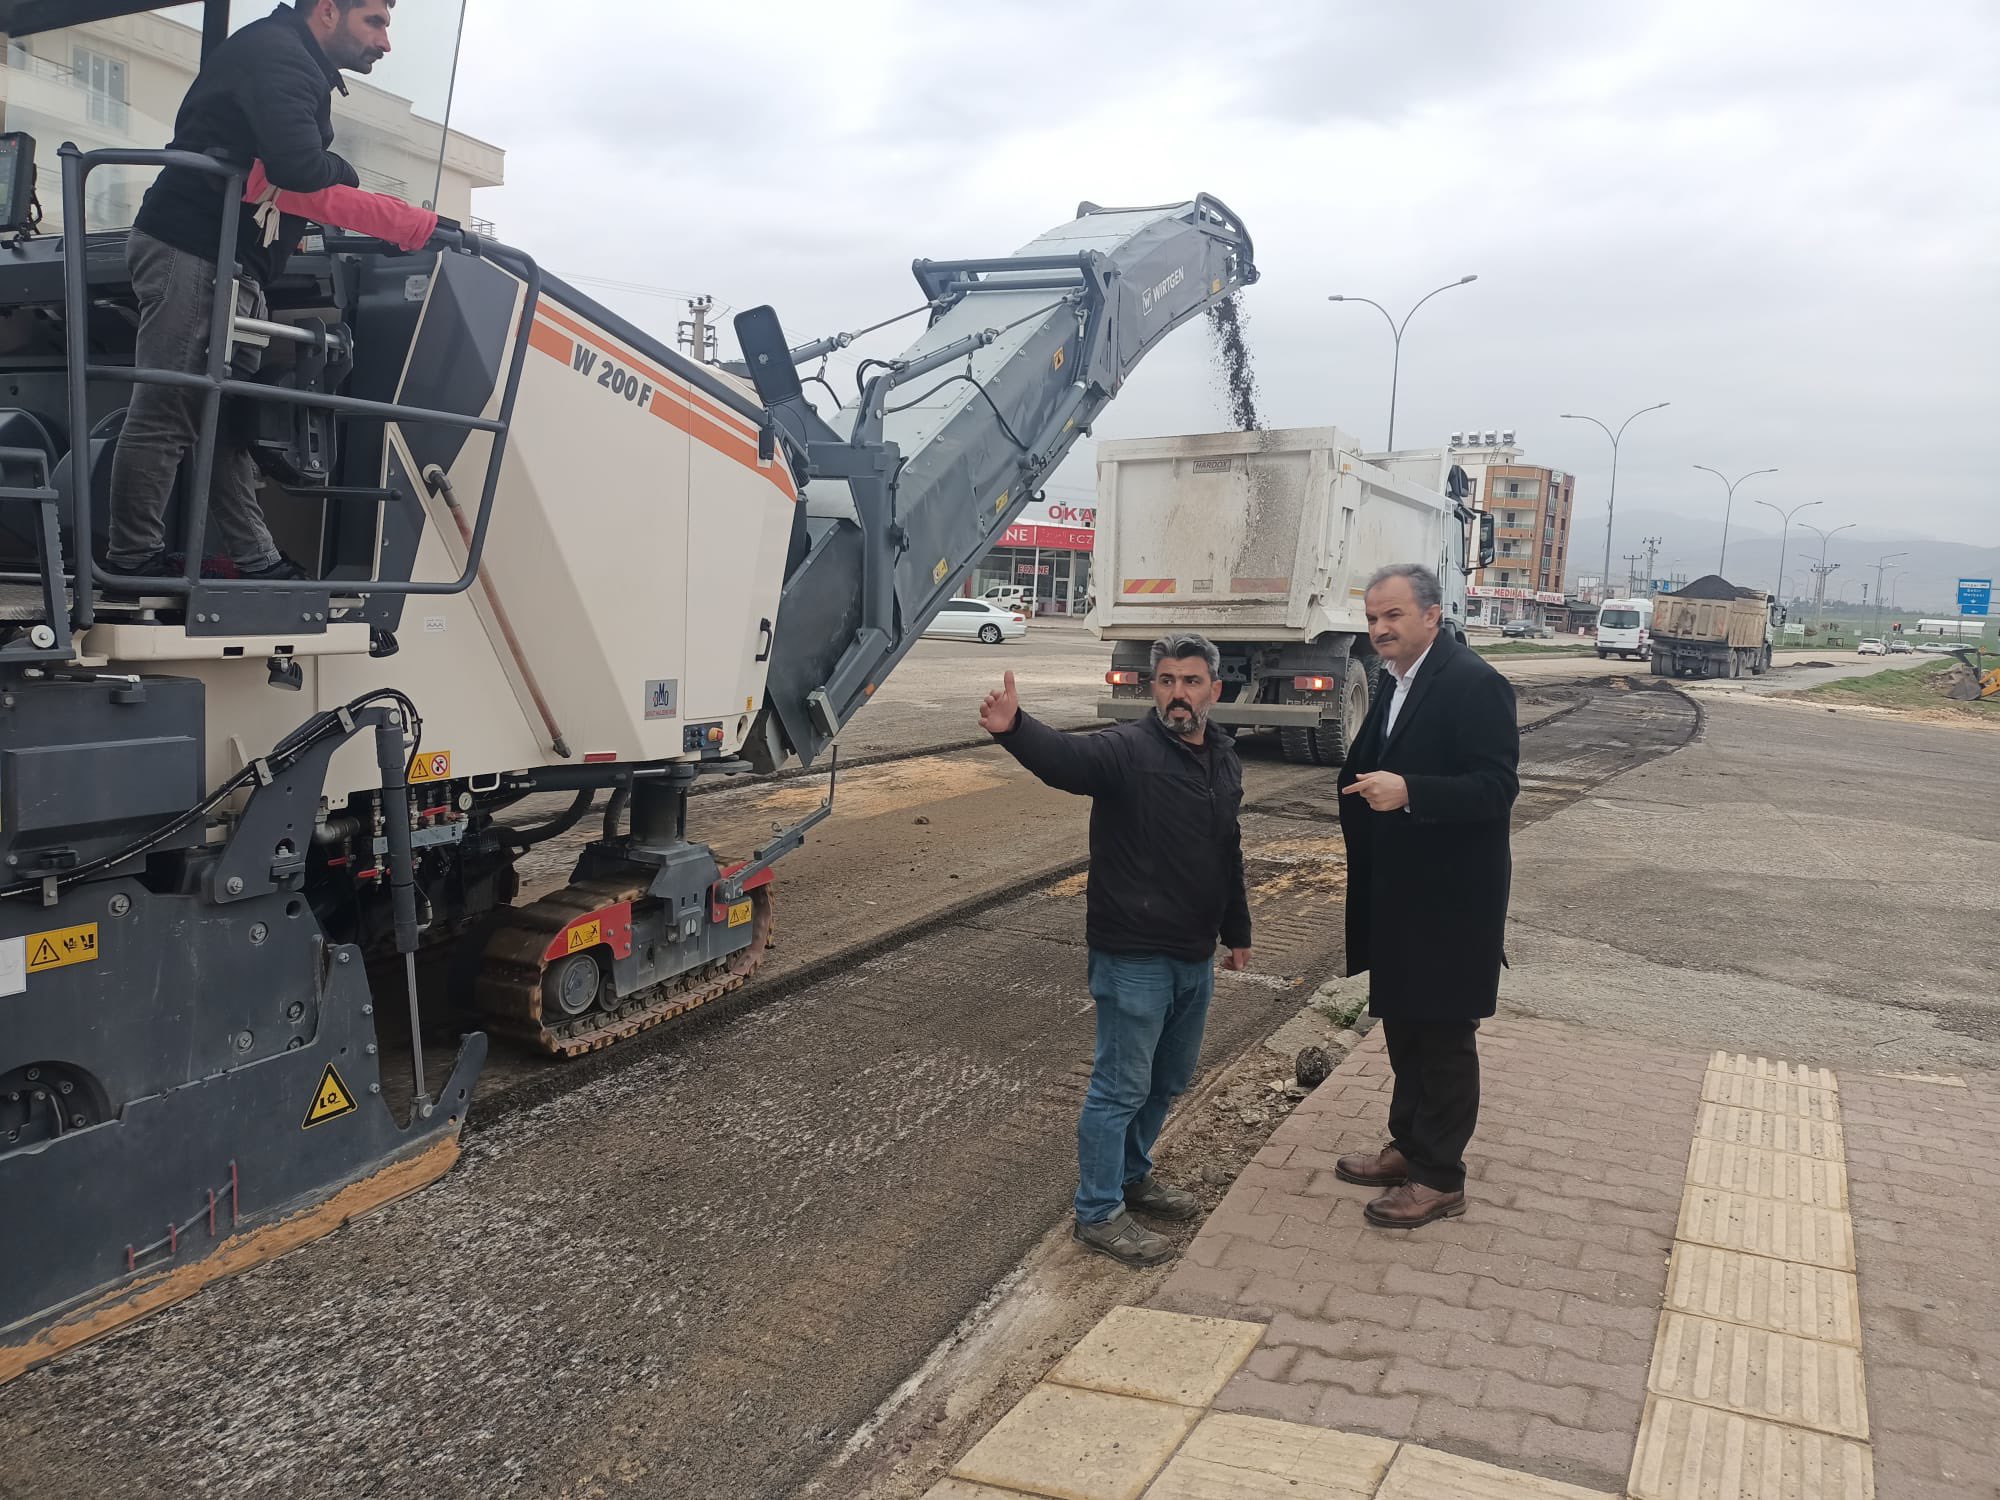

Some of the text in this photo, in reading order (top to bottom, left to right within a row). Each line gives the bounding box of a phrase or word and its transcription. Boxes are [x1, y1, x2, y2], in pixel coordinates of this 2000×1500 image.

[1152, 264, 1184, 303] WIRTGEN
[573, 343, 652, 408] W 200 F
[1195, 461, 1229, 470] HARDOX
